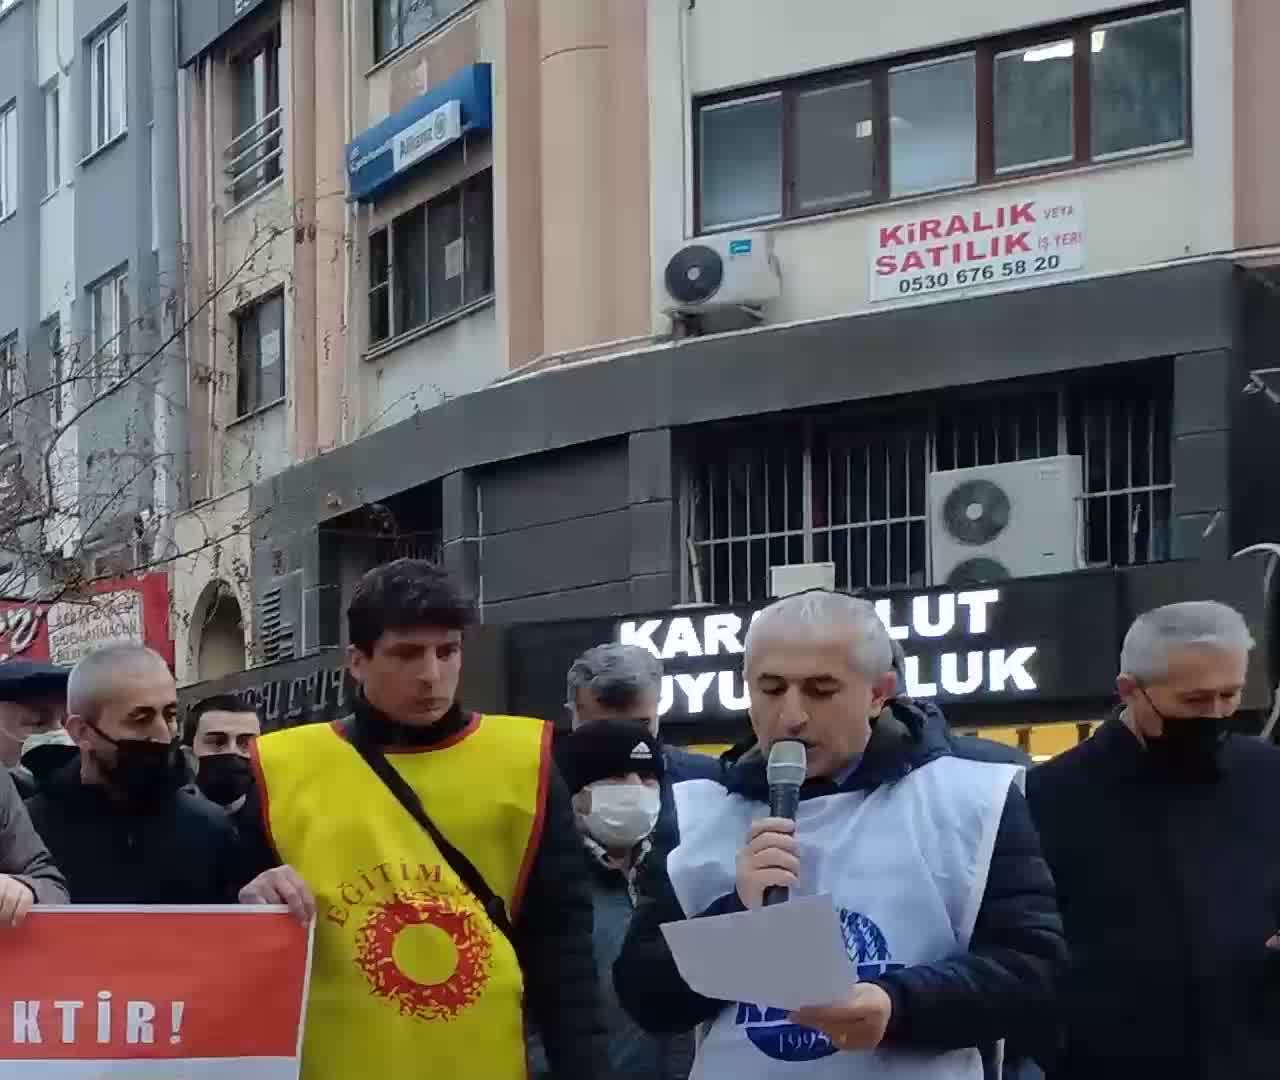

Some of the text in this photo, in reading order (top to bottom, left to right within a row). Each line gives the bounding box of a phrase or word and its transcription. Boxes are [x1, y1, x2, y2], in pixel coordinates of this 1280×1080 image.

[875, 230, 1033, 276] SATILIK
[898, 254, 1060, 293] 0530 676 58 20
[619, 588, 1000, 660] KARLUT
